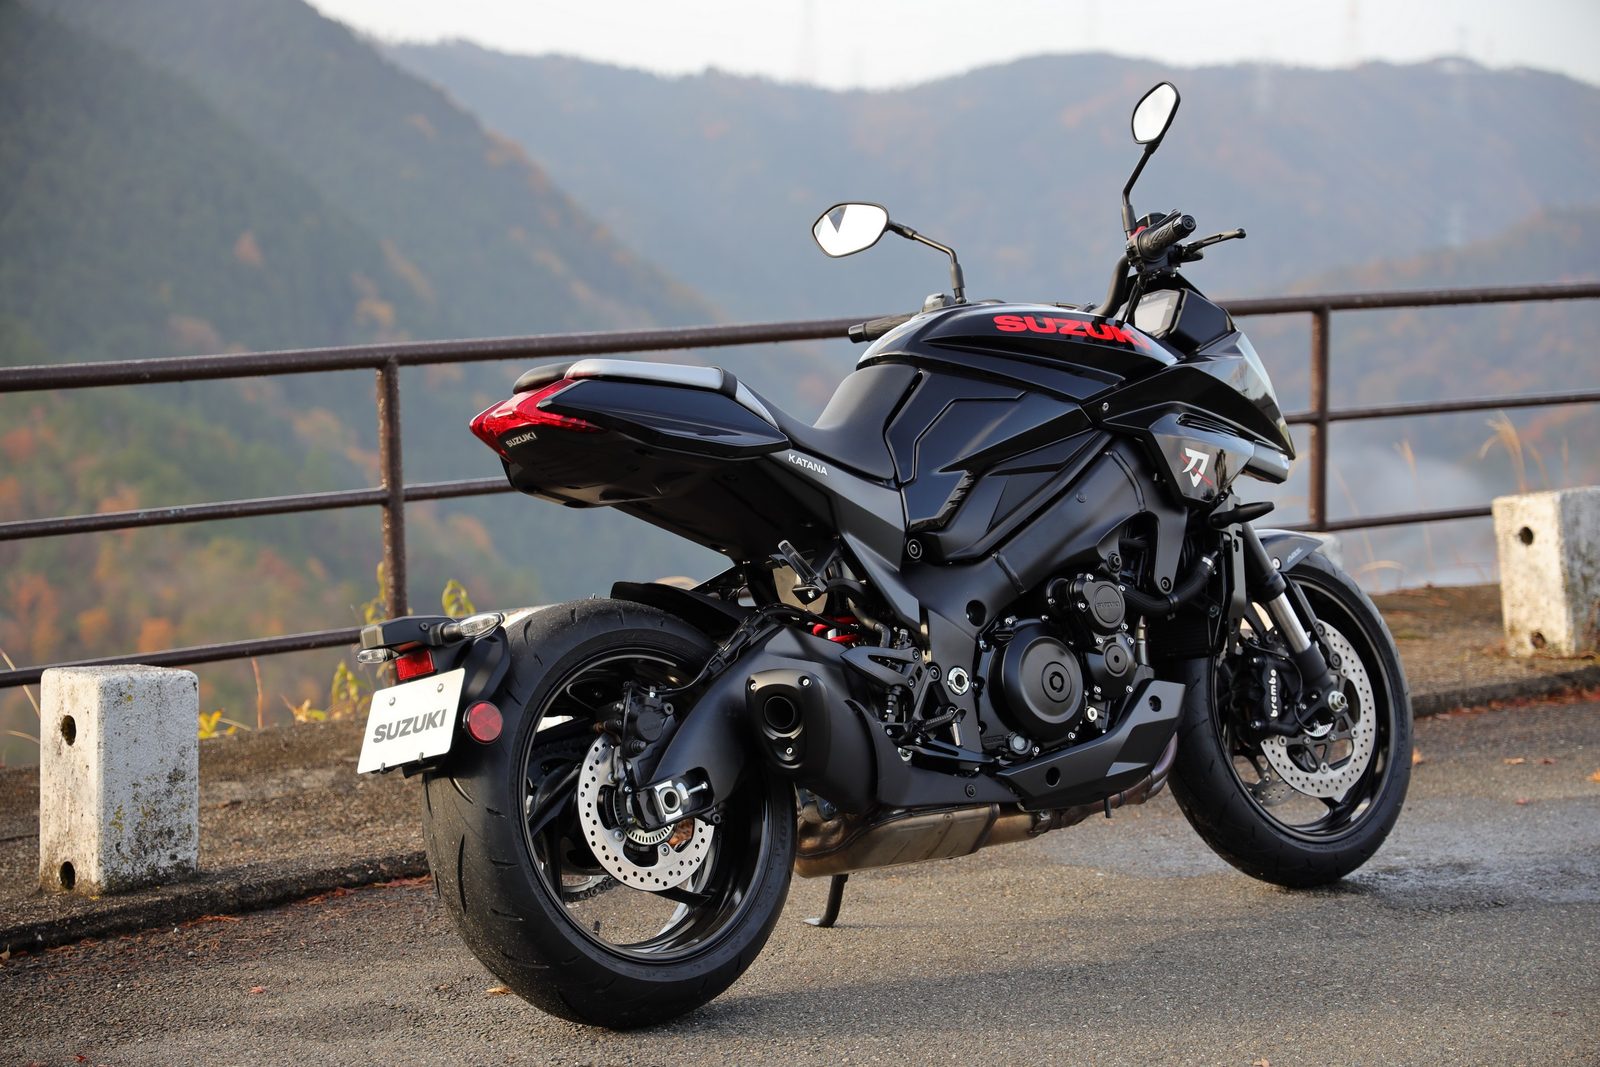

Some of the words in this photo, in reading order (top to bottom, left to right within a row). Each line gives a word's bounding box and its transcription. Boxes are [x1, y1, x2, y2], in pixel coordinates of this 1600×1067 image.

[506, 432, 537, 448] SUZUKI
[788, 453, 828, 476] KATANA
[1269, 669, 1278, 718] brembo
[373, 709, 447, 743] SUZUKI
